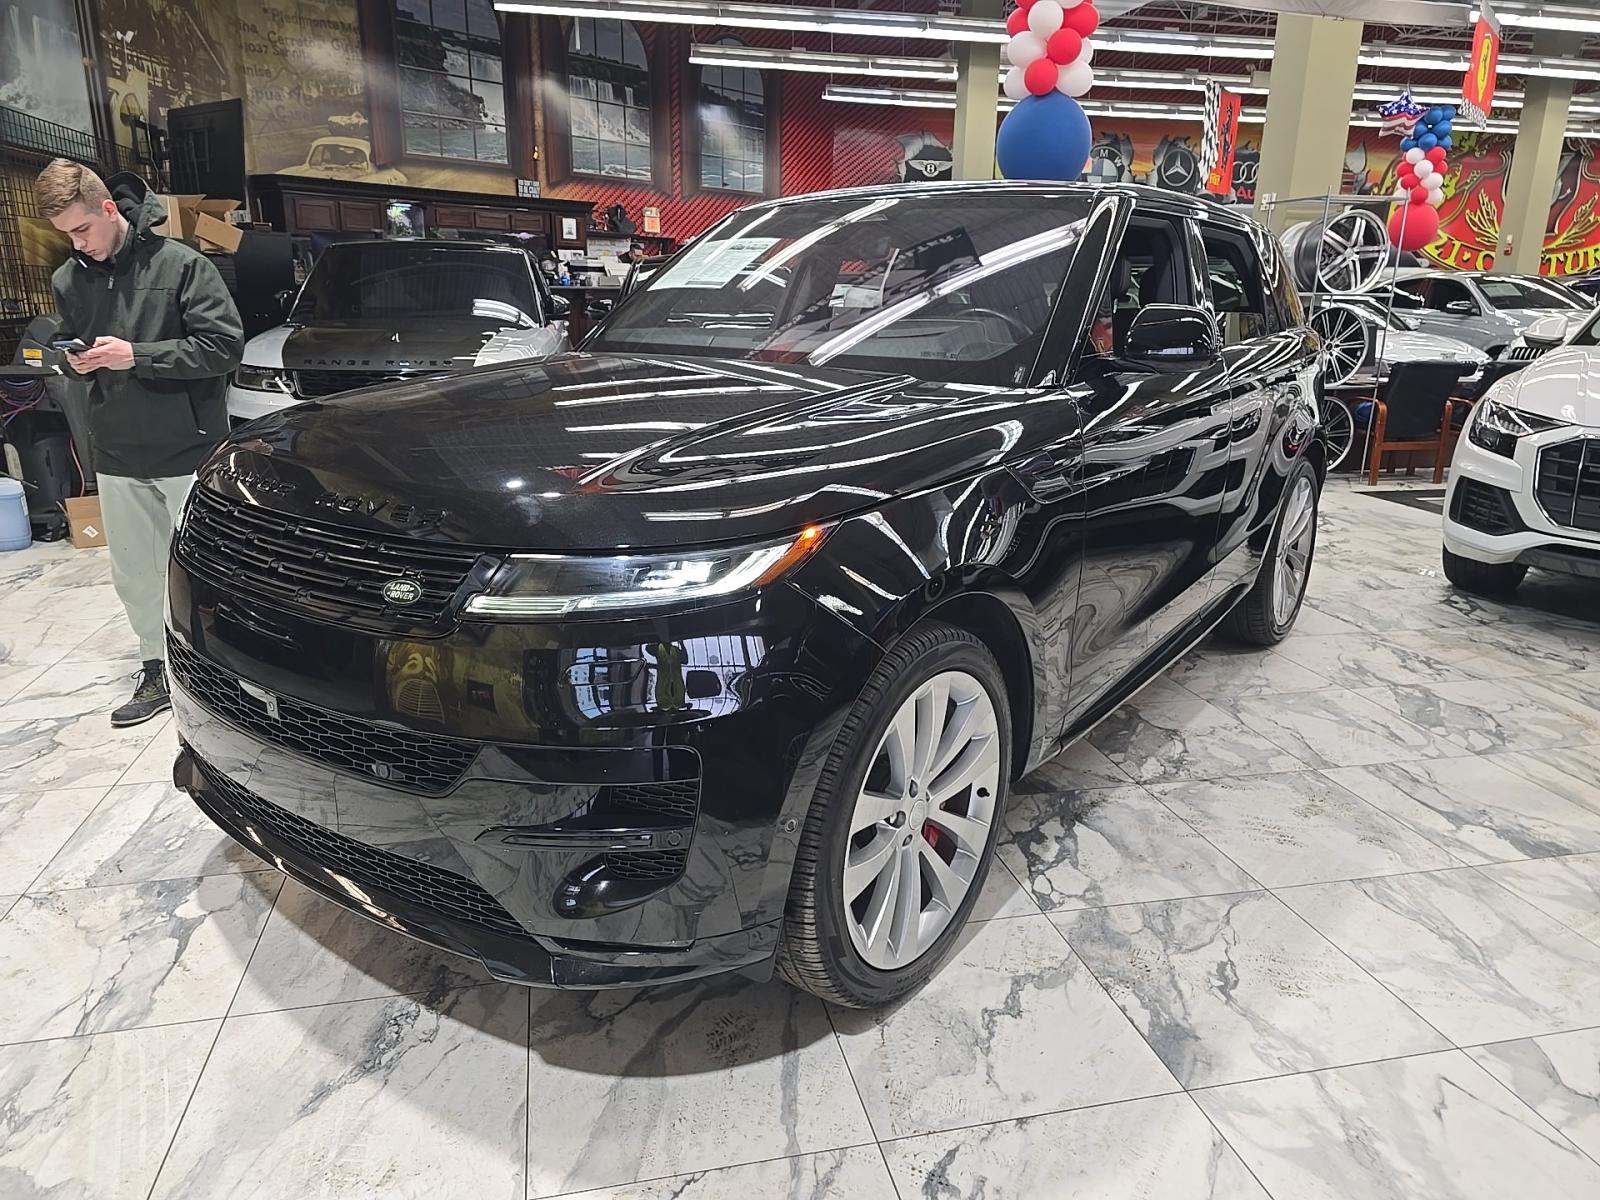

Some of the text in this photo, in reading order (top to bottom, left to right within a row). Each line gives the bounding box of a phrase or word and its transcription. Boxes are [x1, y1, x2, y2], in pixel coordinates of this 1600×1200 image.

[385, 359, 453, 367] ROVER
[313, 491, 448, 526] ROVER
[389, 582, 411, 592] LAND
[389, 590, 414, 601] ROVER
